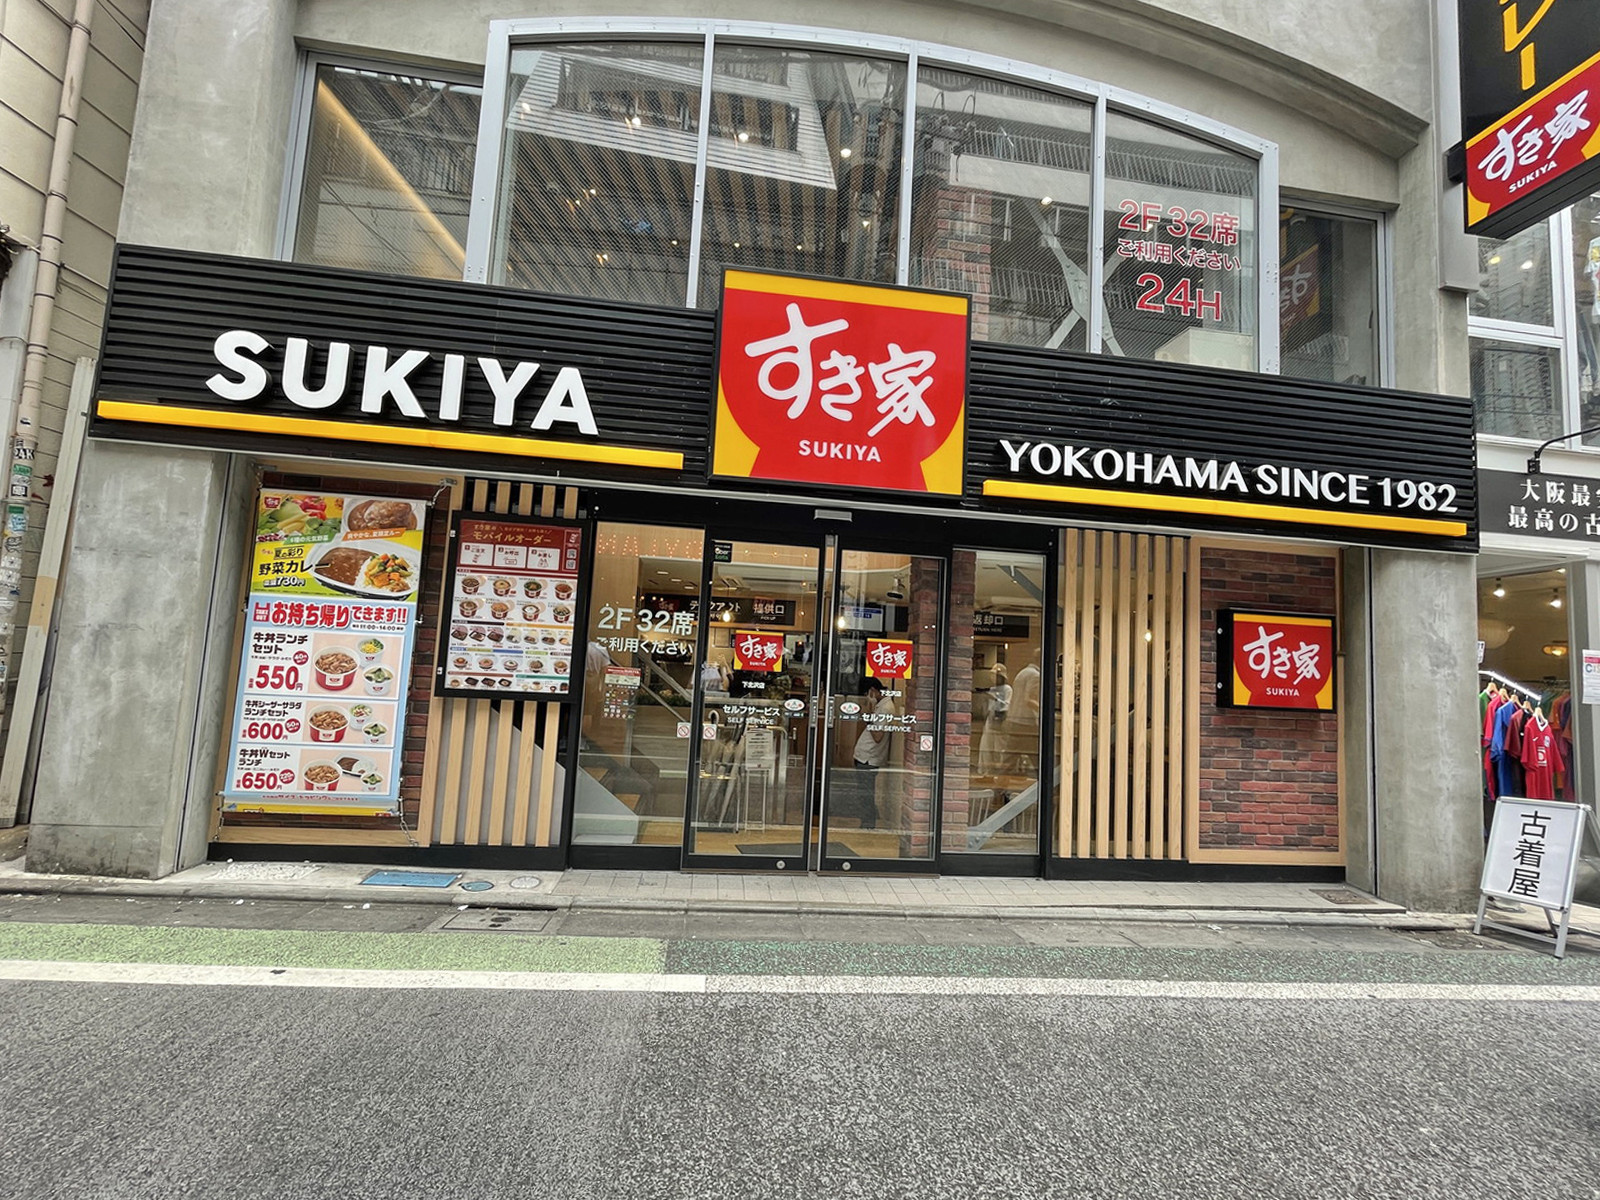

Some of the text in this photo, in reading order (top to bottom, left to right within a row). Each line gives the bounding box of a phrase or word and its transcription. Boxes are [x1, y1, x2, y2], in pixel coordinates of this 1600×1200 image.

[1477, 89, 1591, 181] すき家
[1508, 160, 1558, 193] SUKIYA
[1118, 198, 1239, 246] 2F 32席
[1116, 239, 1241, 271] ご利用ください
[1136, 272, 1222, 322] 24H
[205, 329, 600, 436] SUKIYA
[744, 302, 937, 438] すき家
[798, 439, 882, 463] SUKIYA
[1000, 439, 1459, 514] YOKOHAMA SINCE 1982
[1519, 478, 1600, 509] 大阪最
[472, 531, 552, 545] モバイルオーダー
[258, 560, 332, 576] 野菜カレー
[598, 607, 695, 637] 2F 32席
[252, 644, 284, 655] セット
[253, 632, 309, 645] 牛丼ランチ
[596, 637, 694, 654] ご利用ください
[739, 634, 778, 661] すき家
[870, 642, 908, 669] すき家
[1242, 625, 1322, 686] すき家
[1265, 686, 1300, 697] SUKIYA
[244, 709, 289, 718] ランチセット
[722, 704, 781, 717] セルフサービス
[861, 712, 918, 725] セルフサービス
[238, 759, 263, 767] ランチ
[1507, 810, 1552, 899] 古着屋
